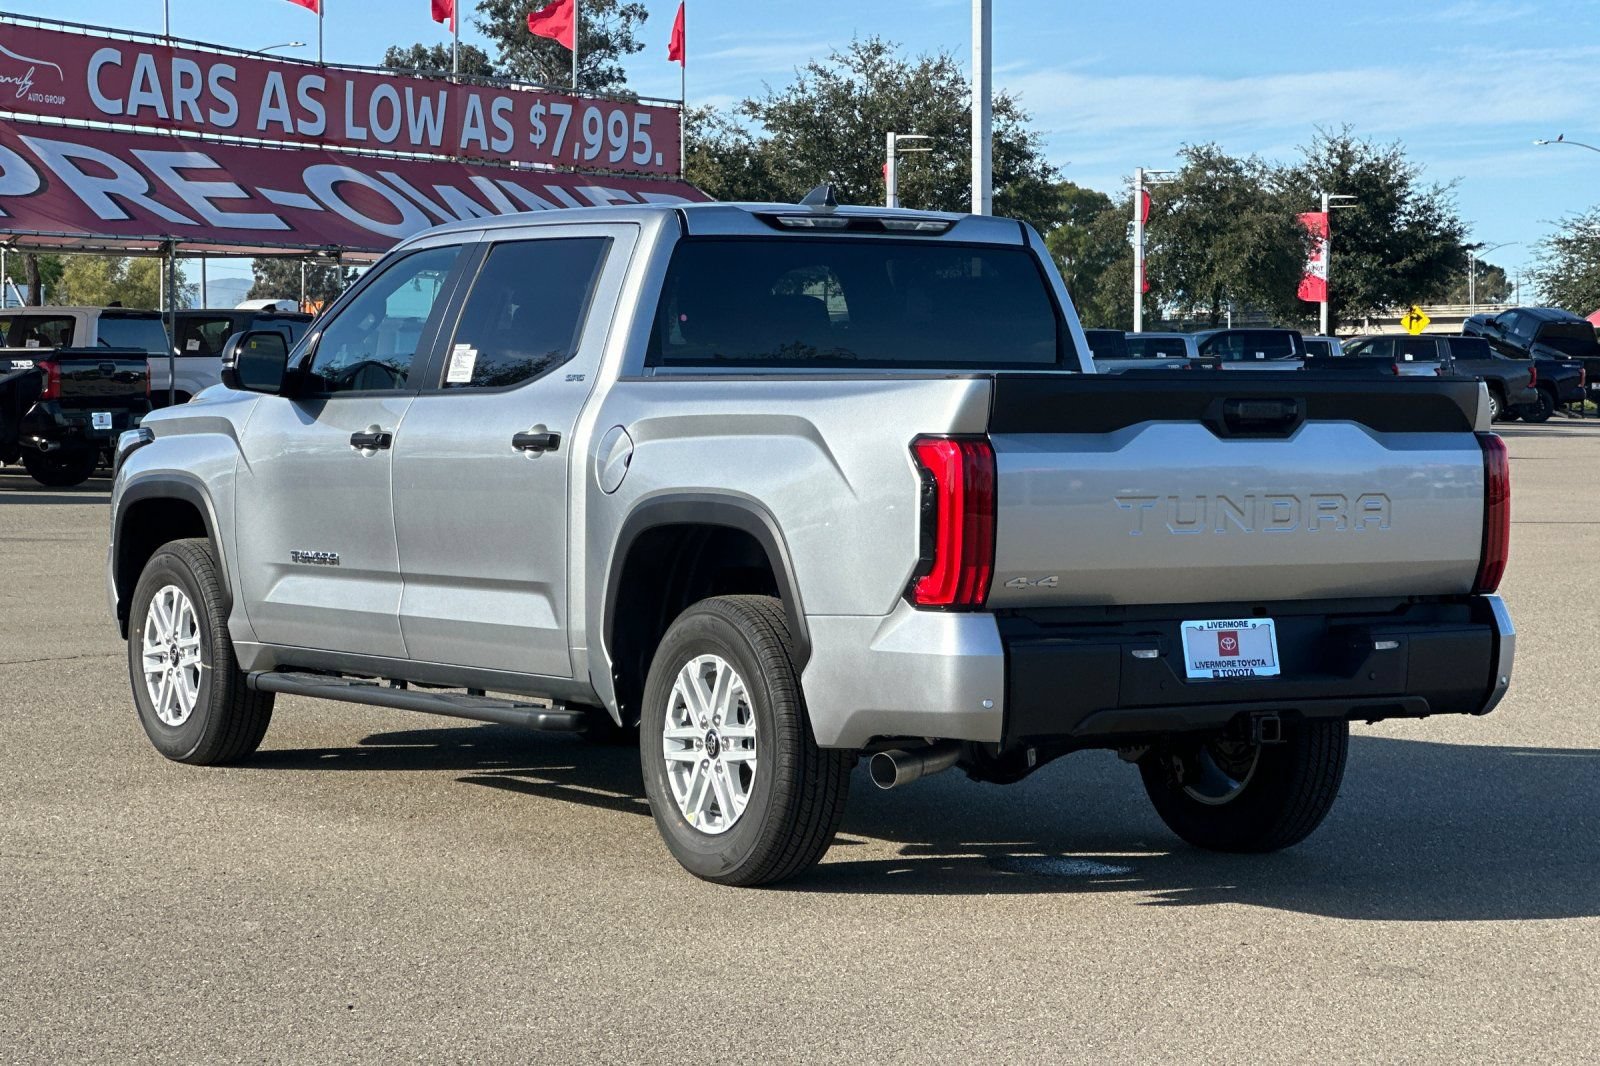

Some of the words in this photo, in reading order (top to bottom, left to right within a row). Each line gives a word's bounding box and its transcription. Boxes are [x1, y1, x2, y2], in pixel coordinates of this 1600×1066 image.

[28, 92, 44, 103] AUTO
[45, 94, 66, 105] GROUP
[87, 48, 239, 127] CARS
[256, 71, 326, 136] AS
[345, 80, 447, 146] LOW
[460, 93, 515, 153] AS
[1113, 493, 1392, 535] TUNDRA
[1206, 620, 1248, 629] LIVERMORE
[1194, 659, 1237, 669] LIVERMORE
[1237, 659, 1266, 667] TOYOTA
[1221, 668, 1256, 677] TOYOTA
